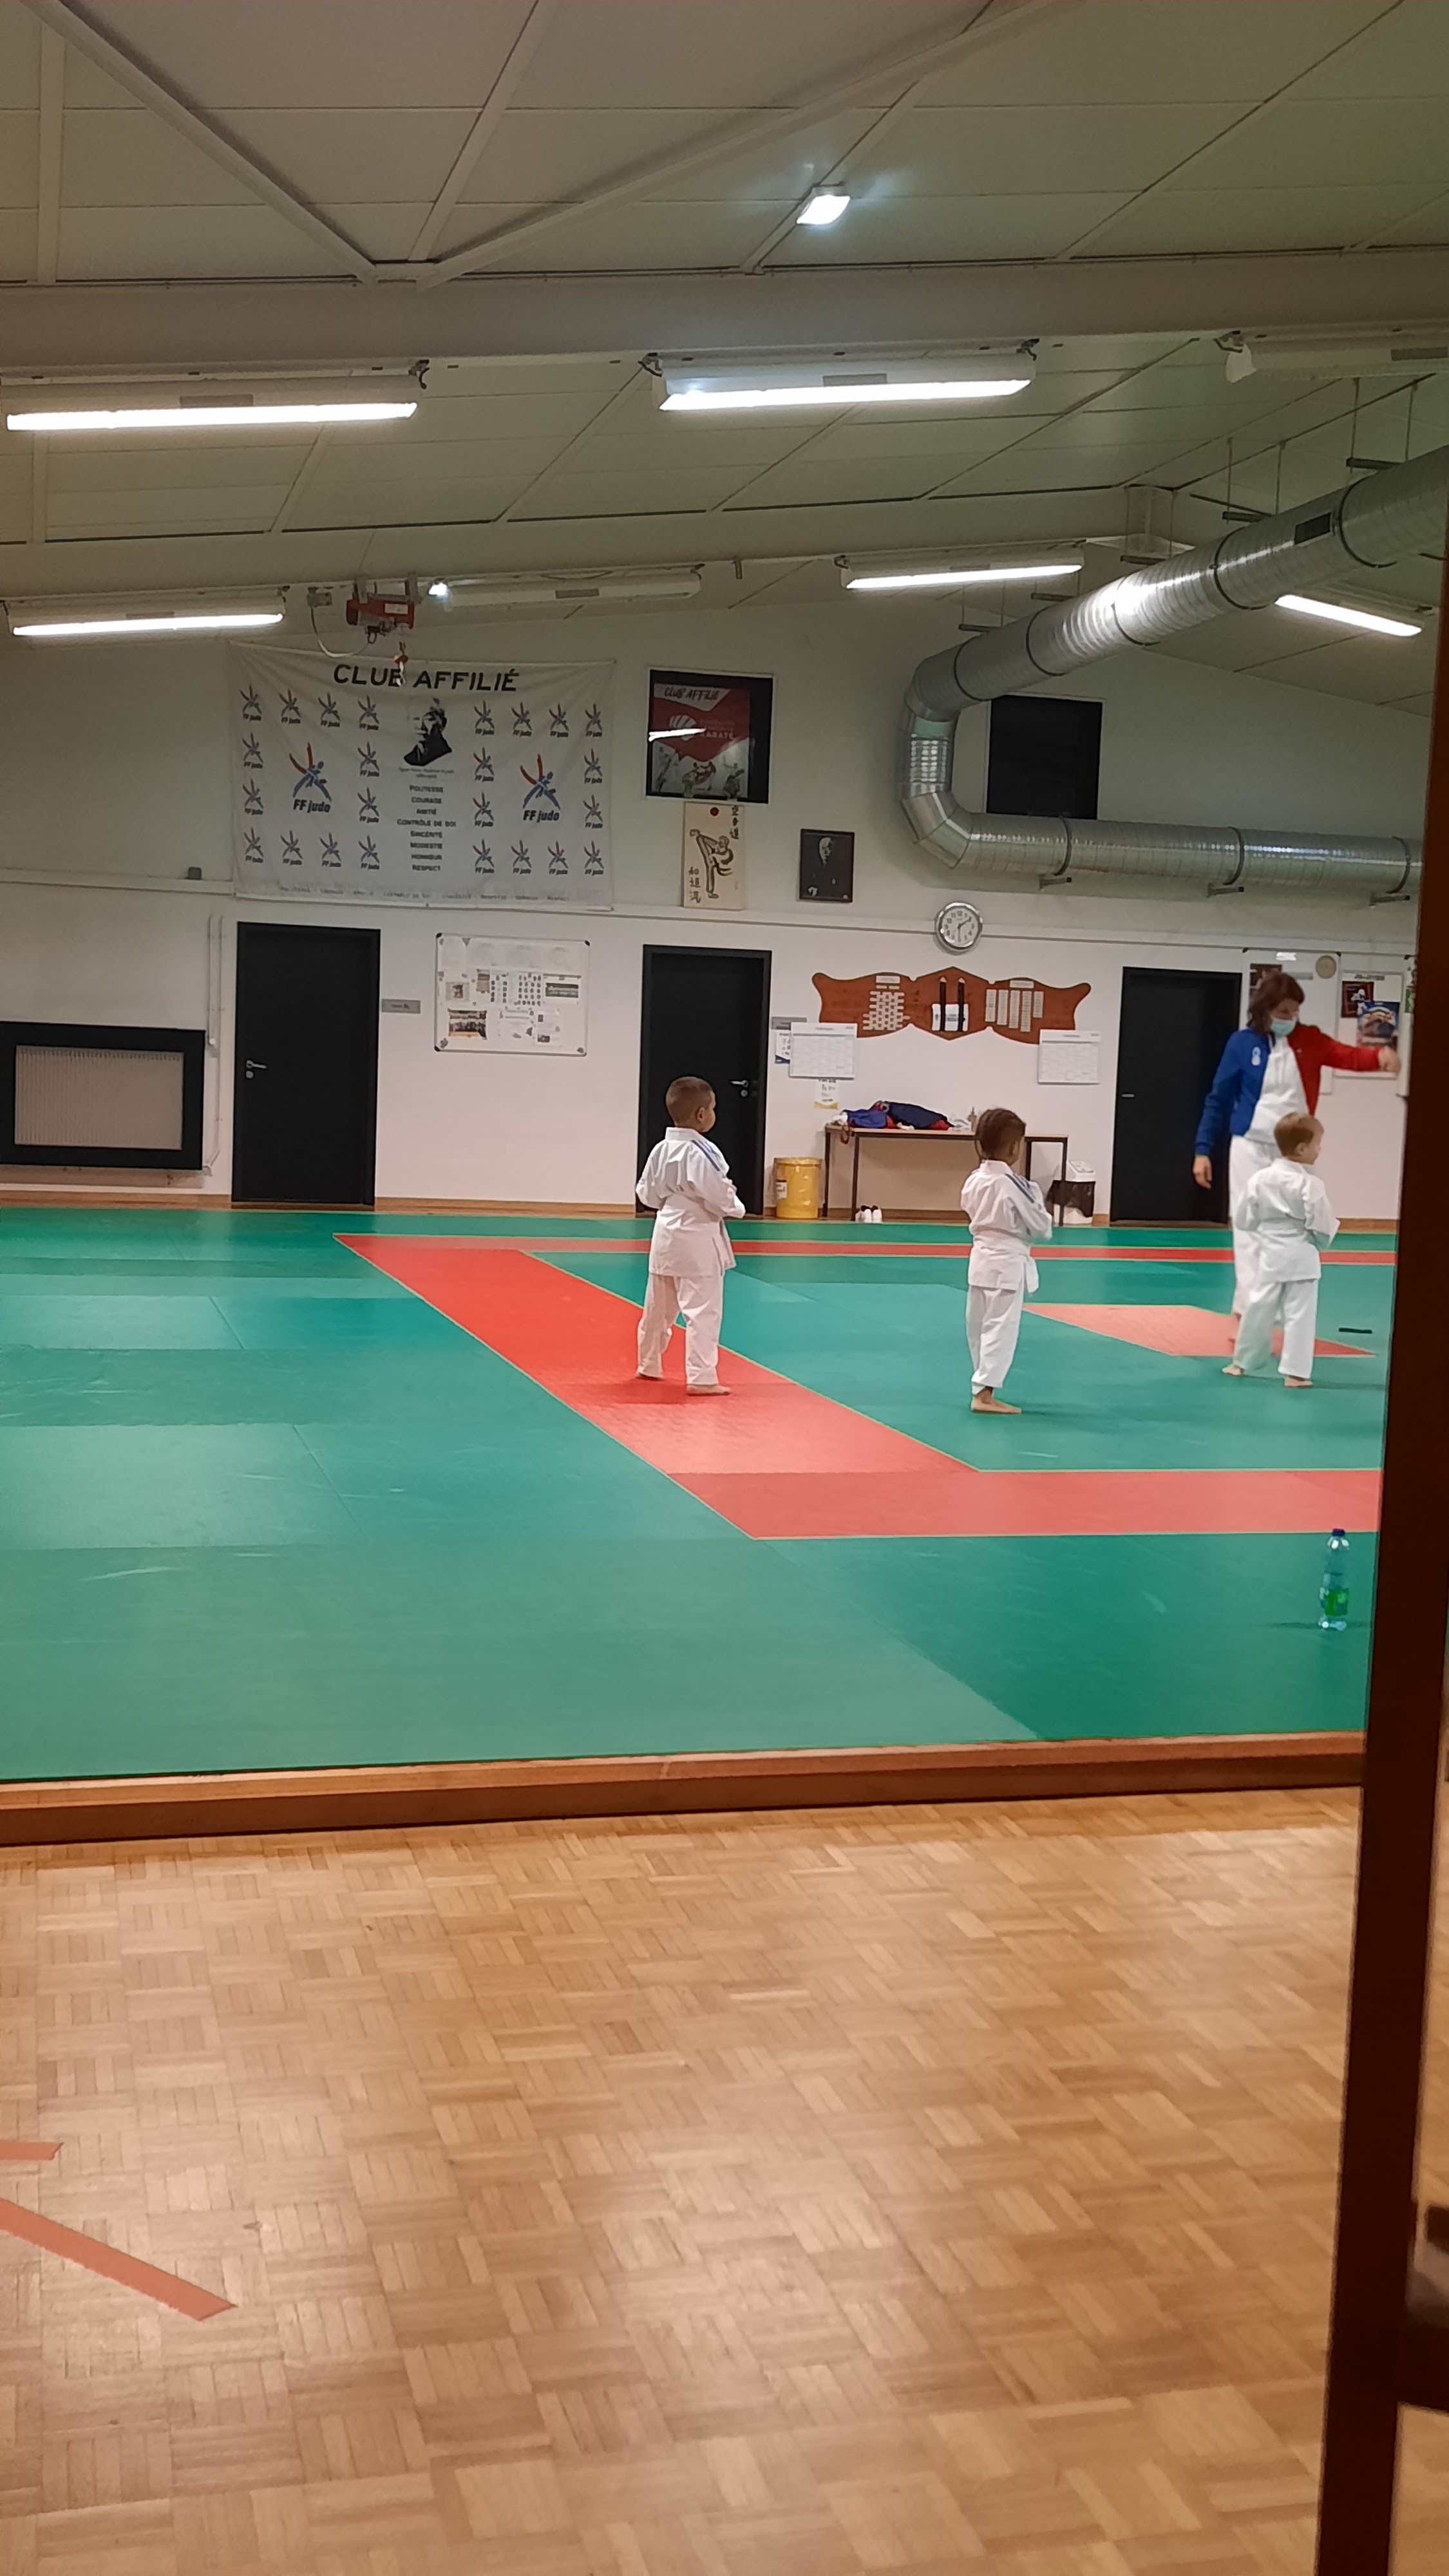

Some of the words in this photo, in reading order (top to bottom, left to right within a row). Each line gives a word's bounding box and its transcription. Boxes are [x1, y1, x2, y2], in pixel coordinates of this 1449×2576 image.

[413, 668, 520, 691] AFFILIÉ
[293, 799, 306, 810] FF
[307, 800, 330, 813] judo
[522, 810, 536, 820] FF
[537, 810, 560, 822] judo
